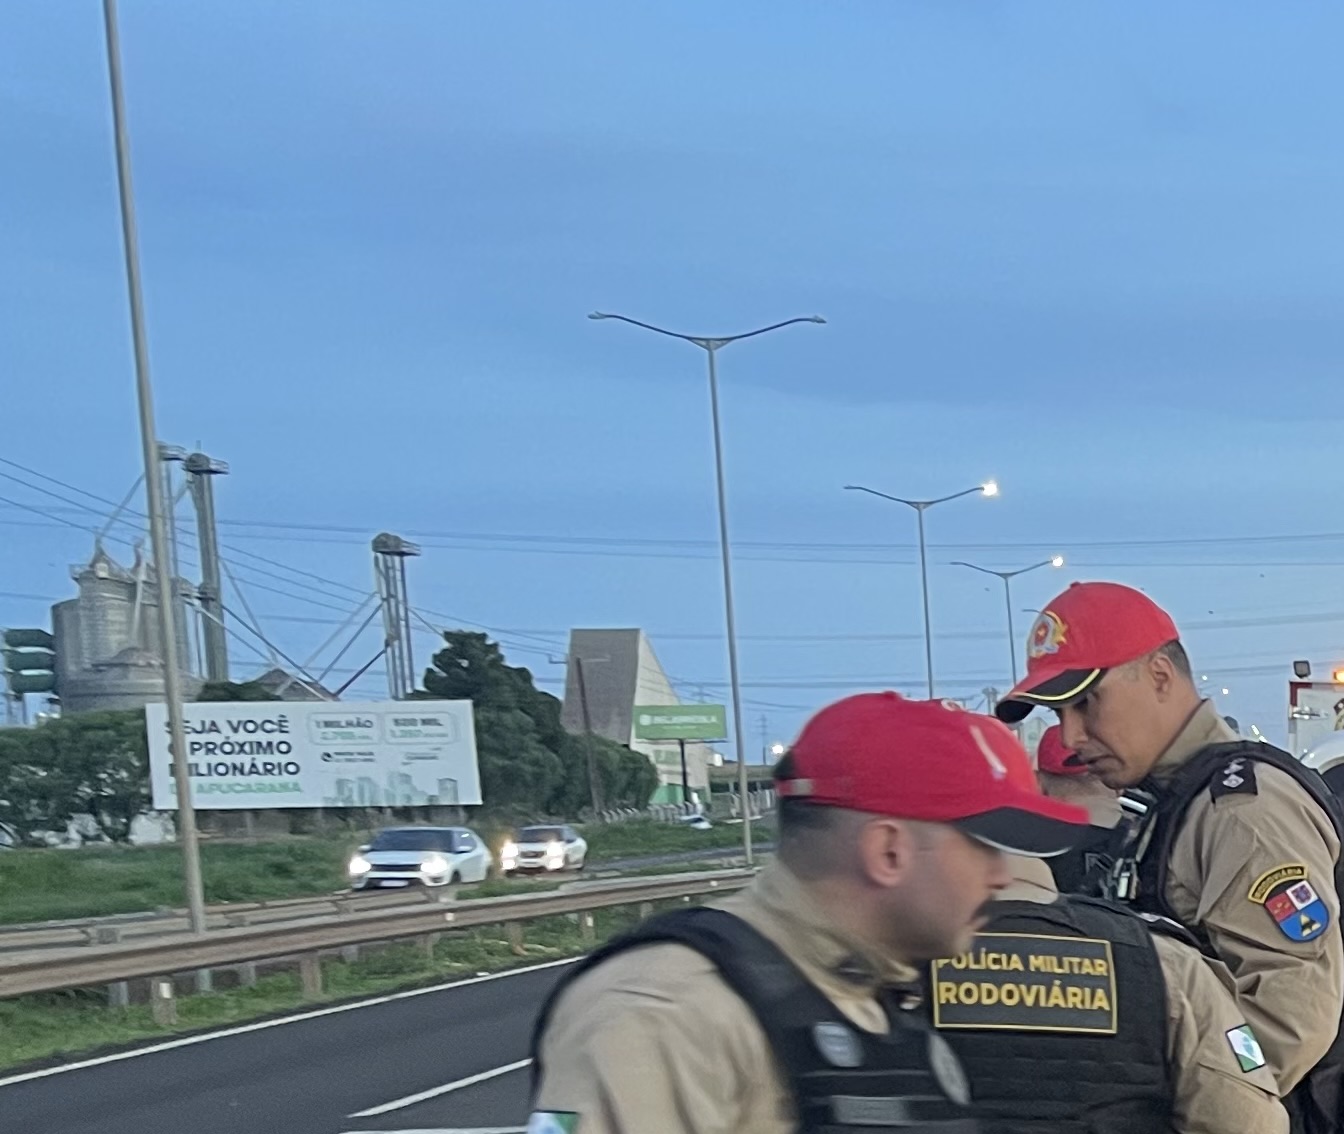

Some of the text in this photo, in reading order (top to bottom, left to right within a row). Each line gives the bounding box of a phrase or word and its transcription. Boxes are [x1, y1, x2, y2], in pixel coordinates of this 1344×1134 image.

[226, 714, 290, 734] VOCÊ
[189, 736, 293, 756] PRÓXIMO
[1028, 954, 1109, 976] MILITAR
[938, 979, 1110, 1011] RODOVIÁRIA
